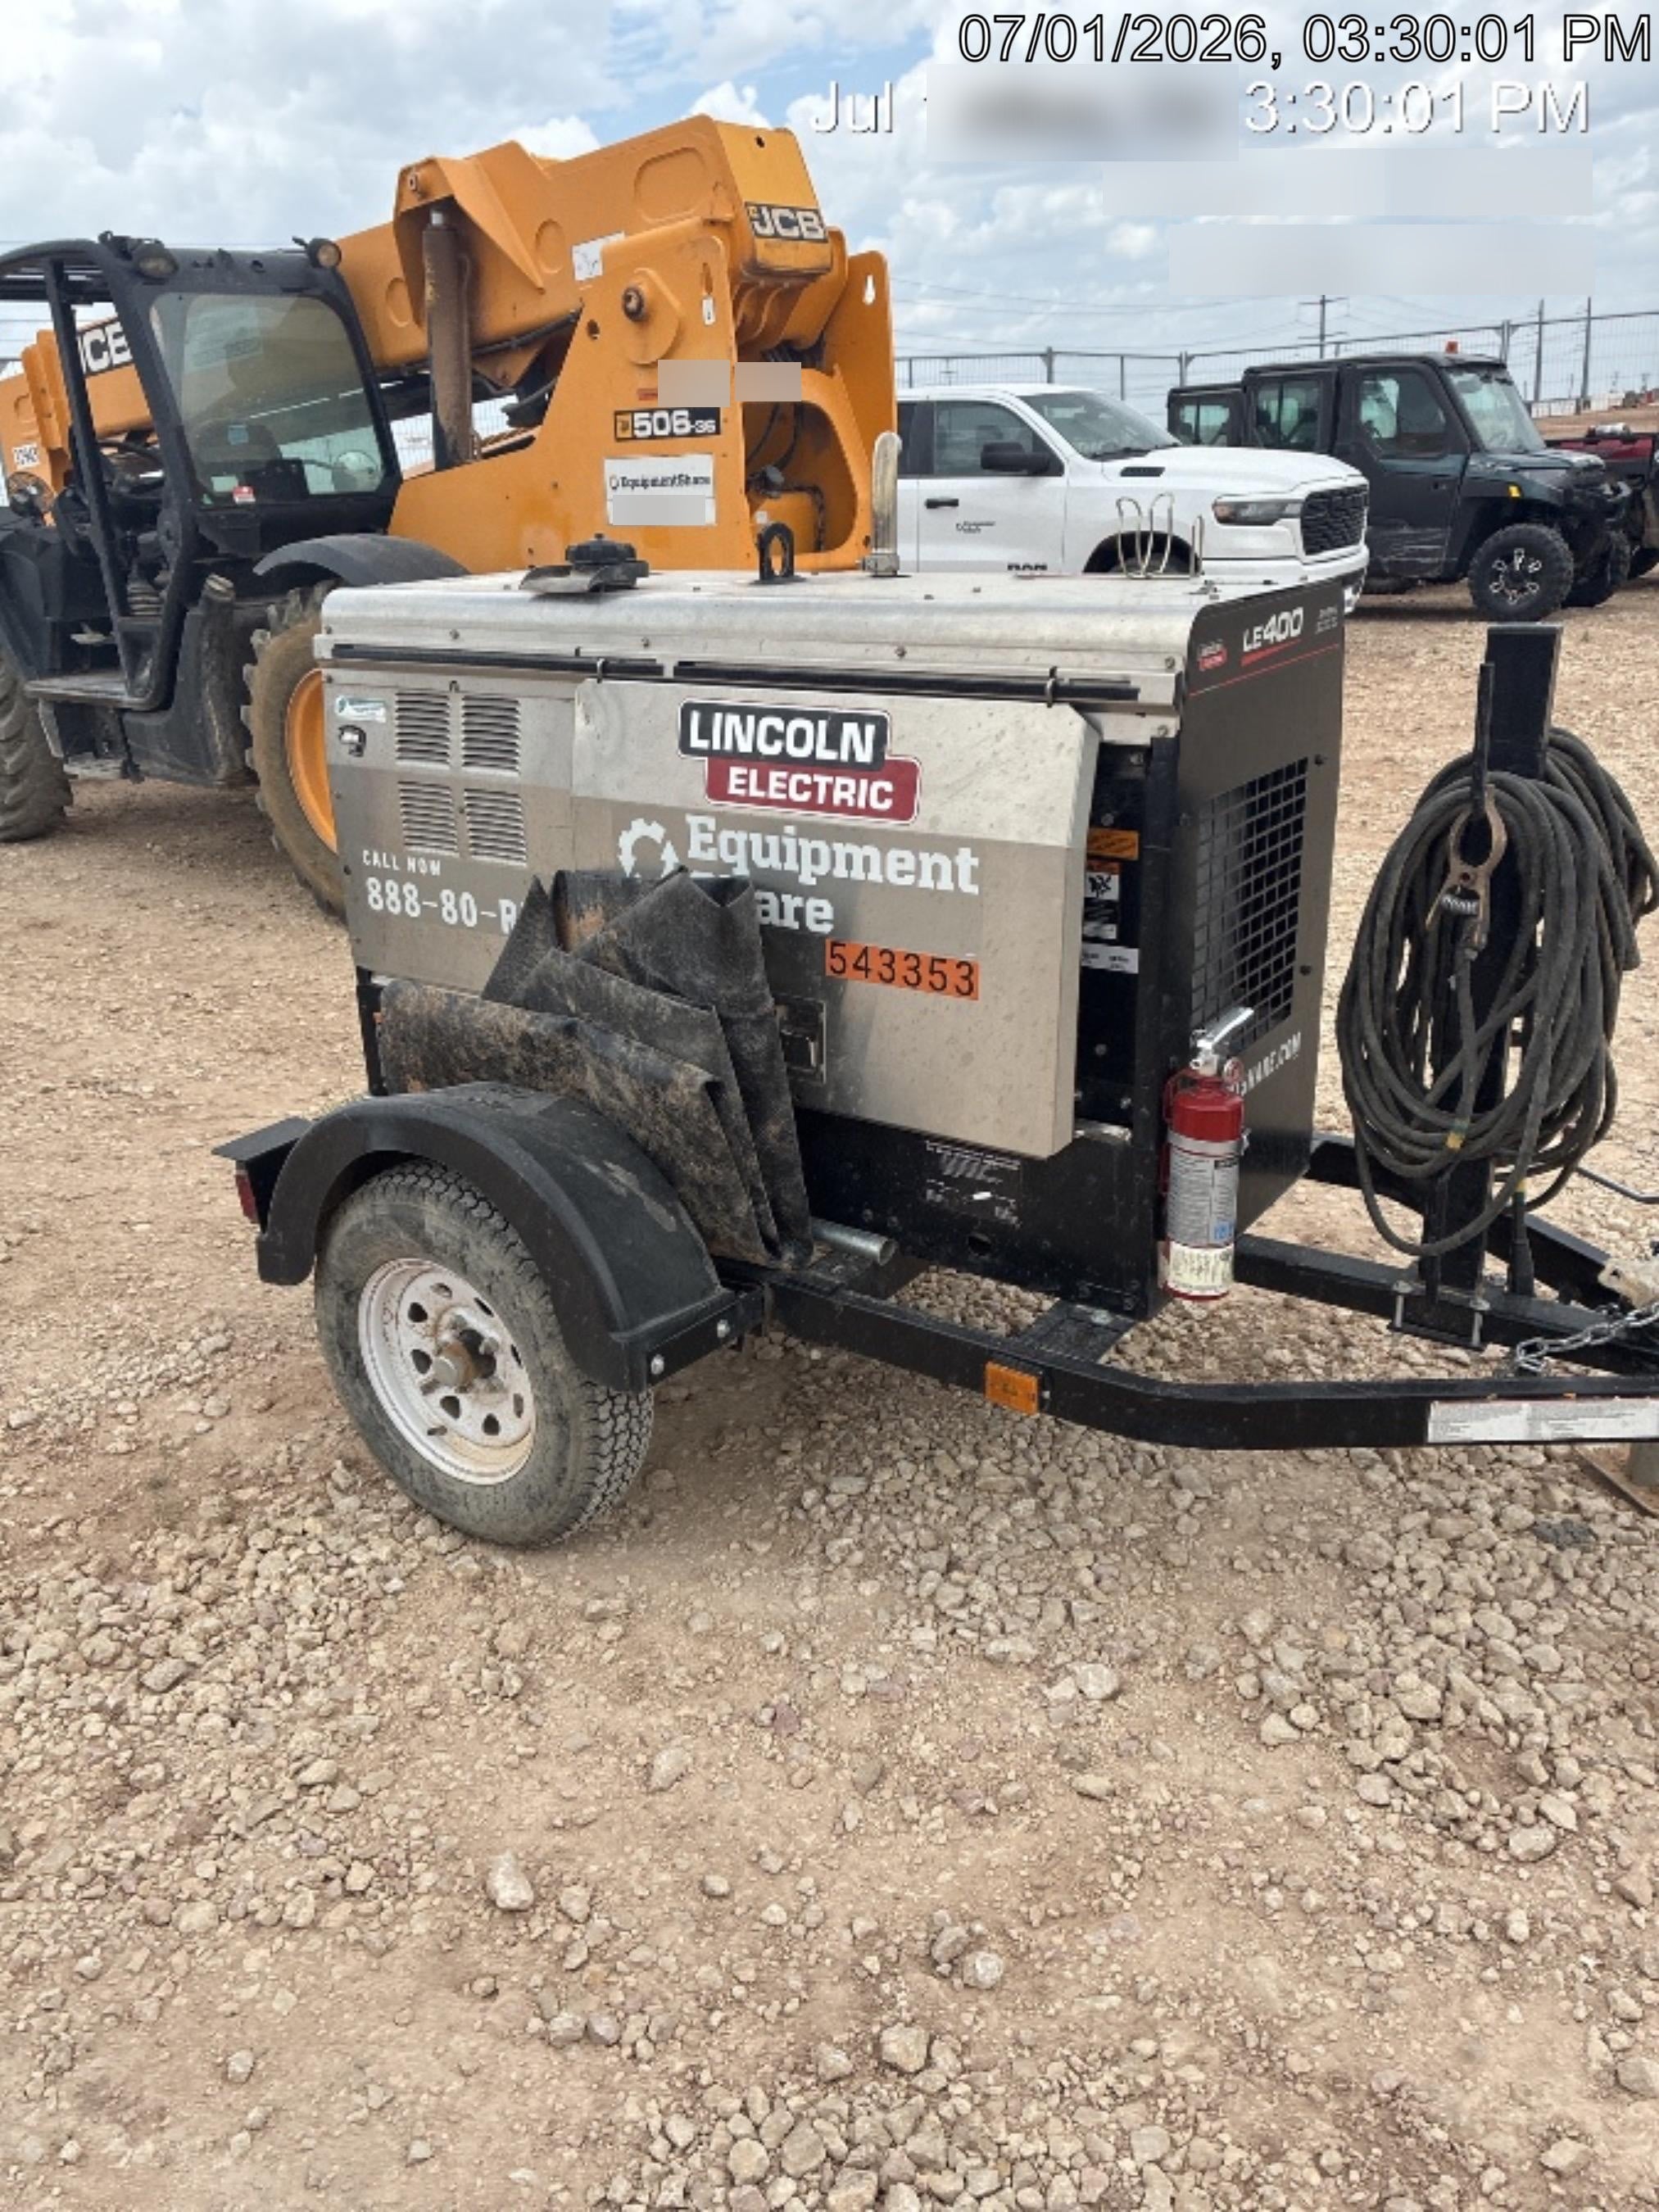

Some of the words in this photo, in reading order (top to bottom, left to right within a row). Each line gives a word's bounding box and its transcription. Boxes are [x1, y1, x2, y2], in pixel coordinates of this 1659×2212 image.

[751, 206, 826, 239] JCB
[78, 321, 134, 374] CB
[1243, 607, 1304, 652] LE400
[689, 710, 876, 763] LINCOLN
[727, 766, 895, 810] ELECTRIC
[363, 850, 401, 871] CALL
[407, 858, 441, 876] NOW
[685, 814, 979, 895] Equipment
[365, 876, 525, 935] 888-80-R
[829, 942, 975, 997] 543353
